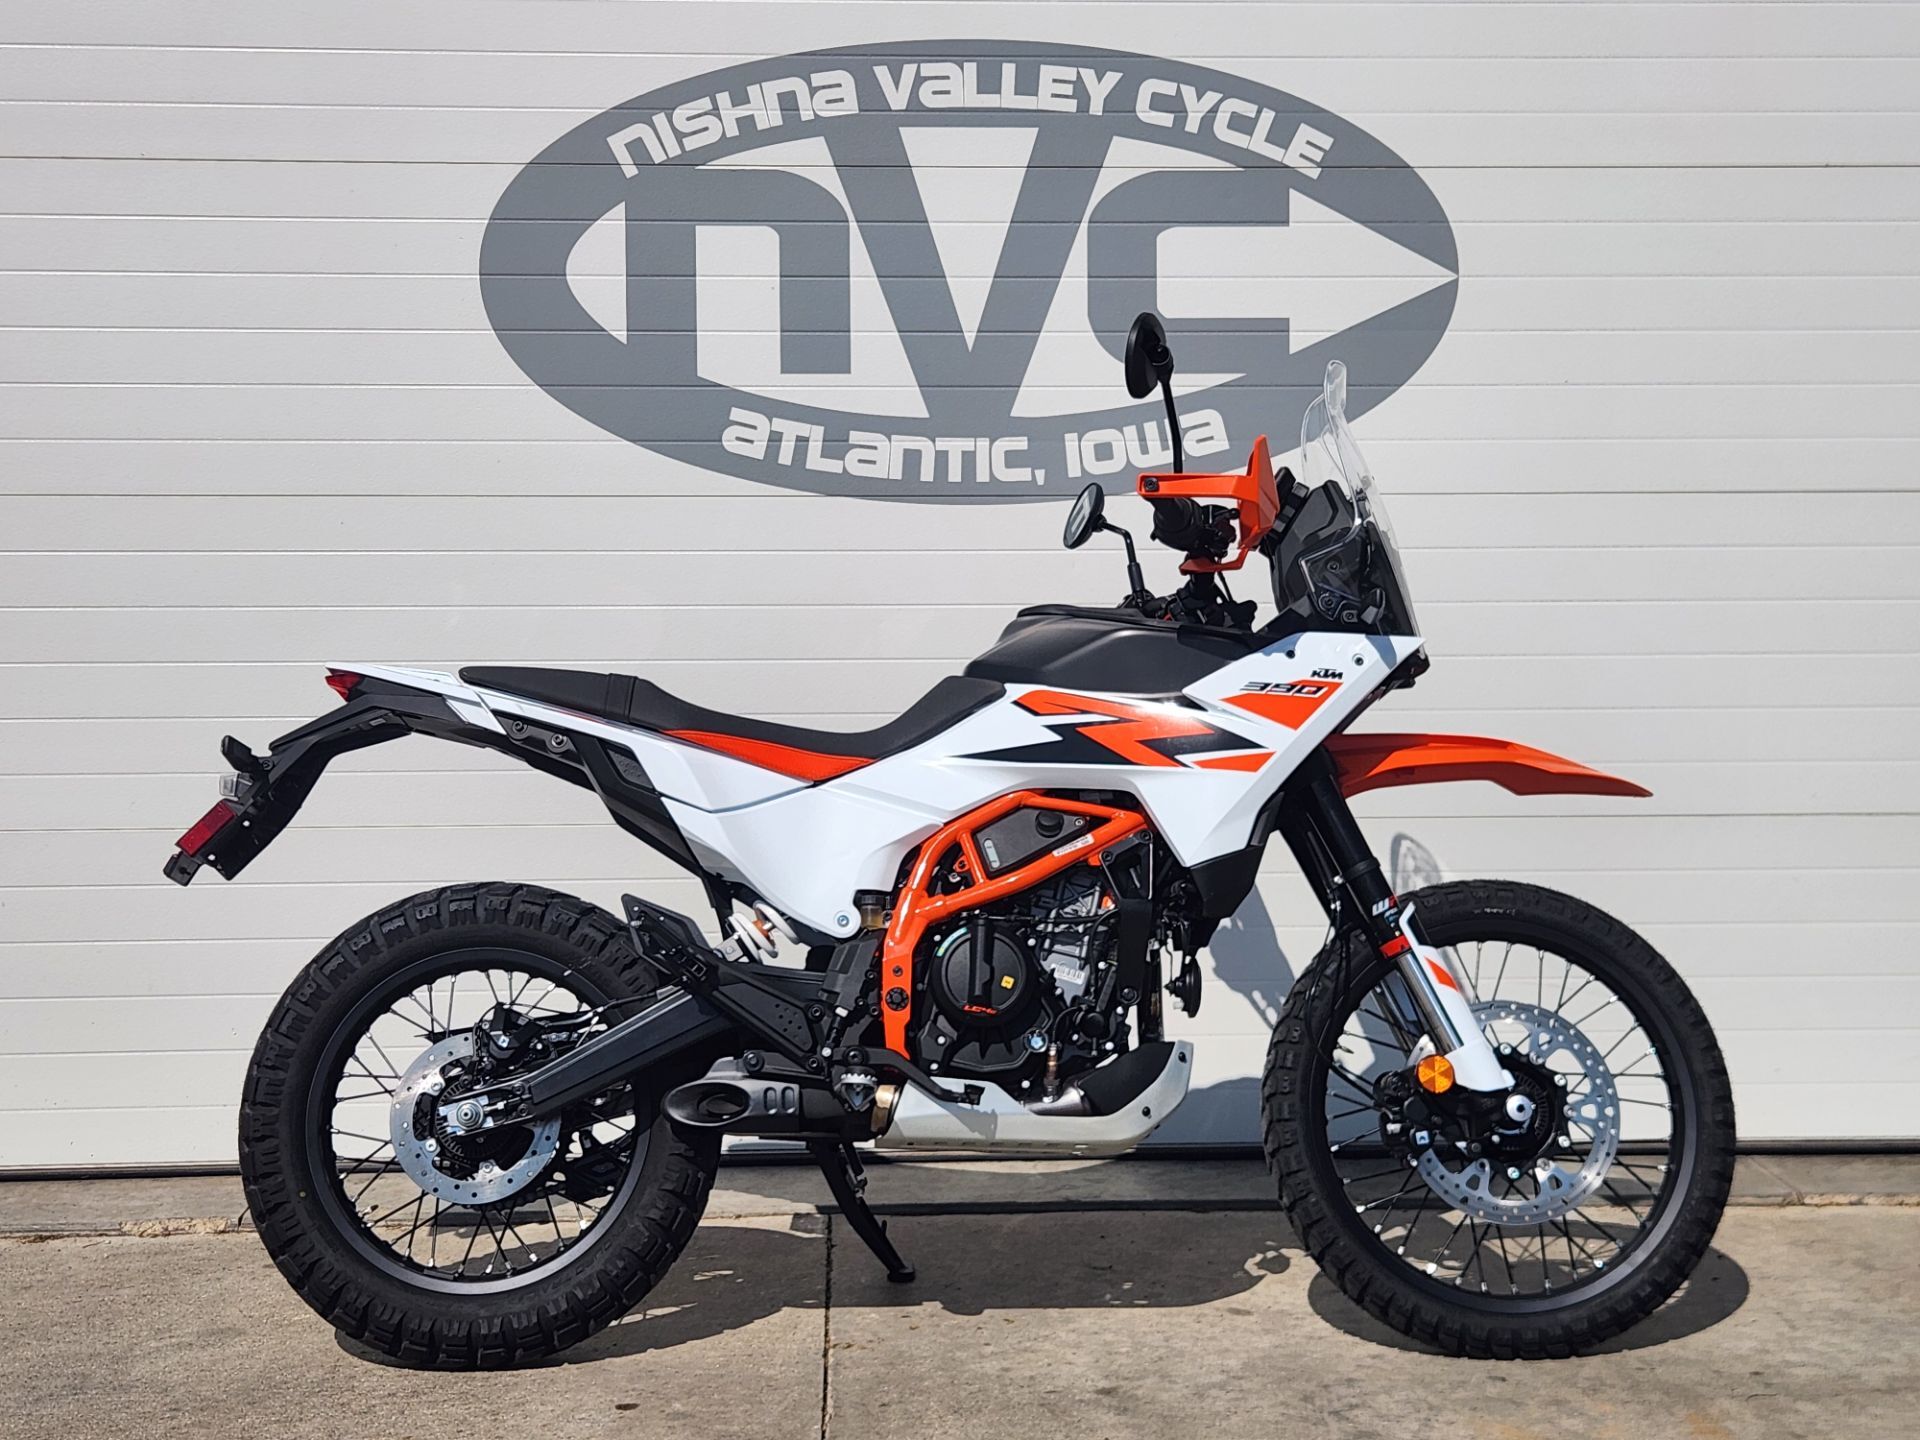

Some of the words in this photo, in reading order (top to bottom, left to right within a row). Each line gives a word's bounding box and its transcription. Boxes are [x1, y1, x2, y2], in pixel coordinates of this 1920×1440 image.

[1135, 78, 1335, 180] CYCLE
[1310, 668, 1344, 680] KTM
[1240, 681, 1325, 697] 390
